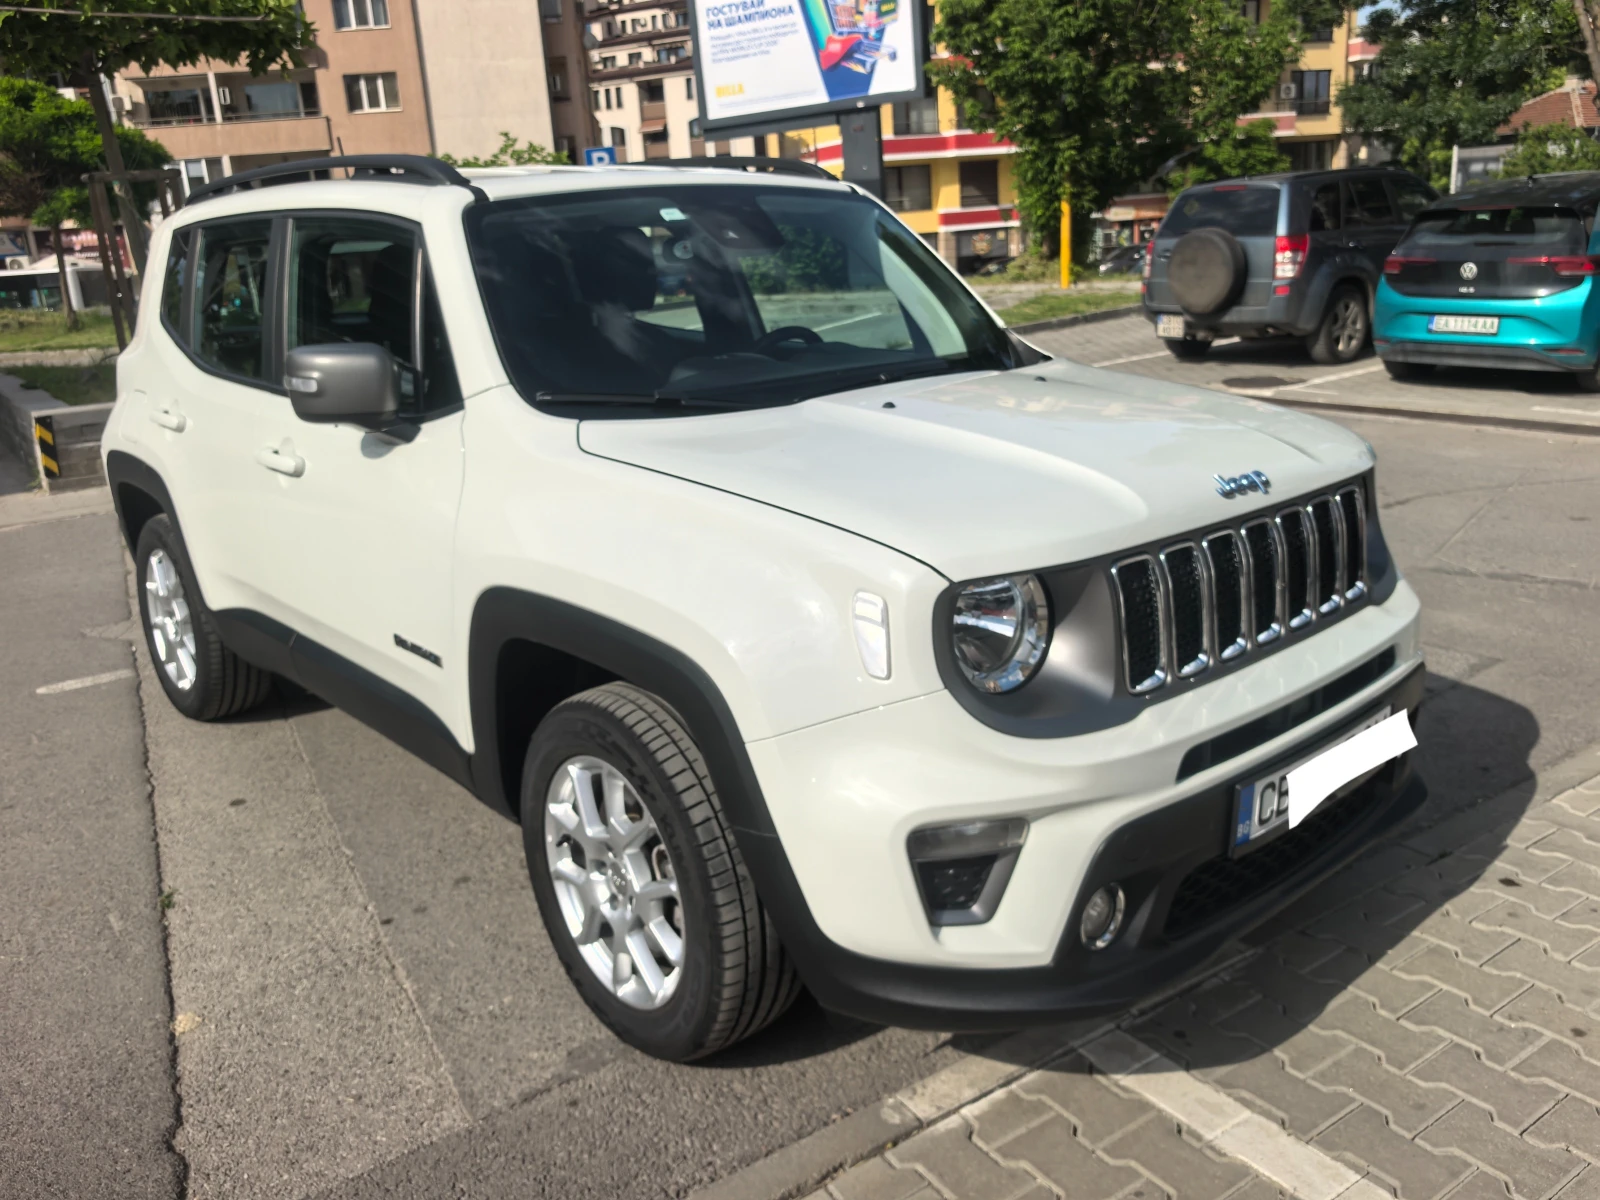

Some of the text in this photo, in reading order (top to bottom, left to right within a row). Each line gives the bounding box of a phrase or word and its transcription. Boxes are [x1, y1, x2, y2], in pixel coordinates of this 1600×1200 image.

[707, 5, 794, 30] НА ШАМПИОНА
[591, 151, 610, 167] P
[1213, 470, 1271, 500] Jeep
[1237, 820, 1250, 838] BG
